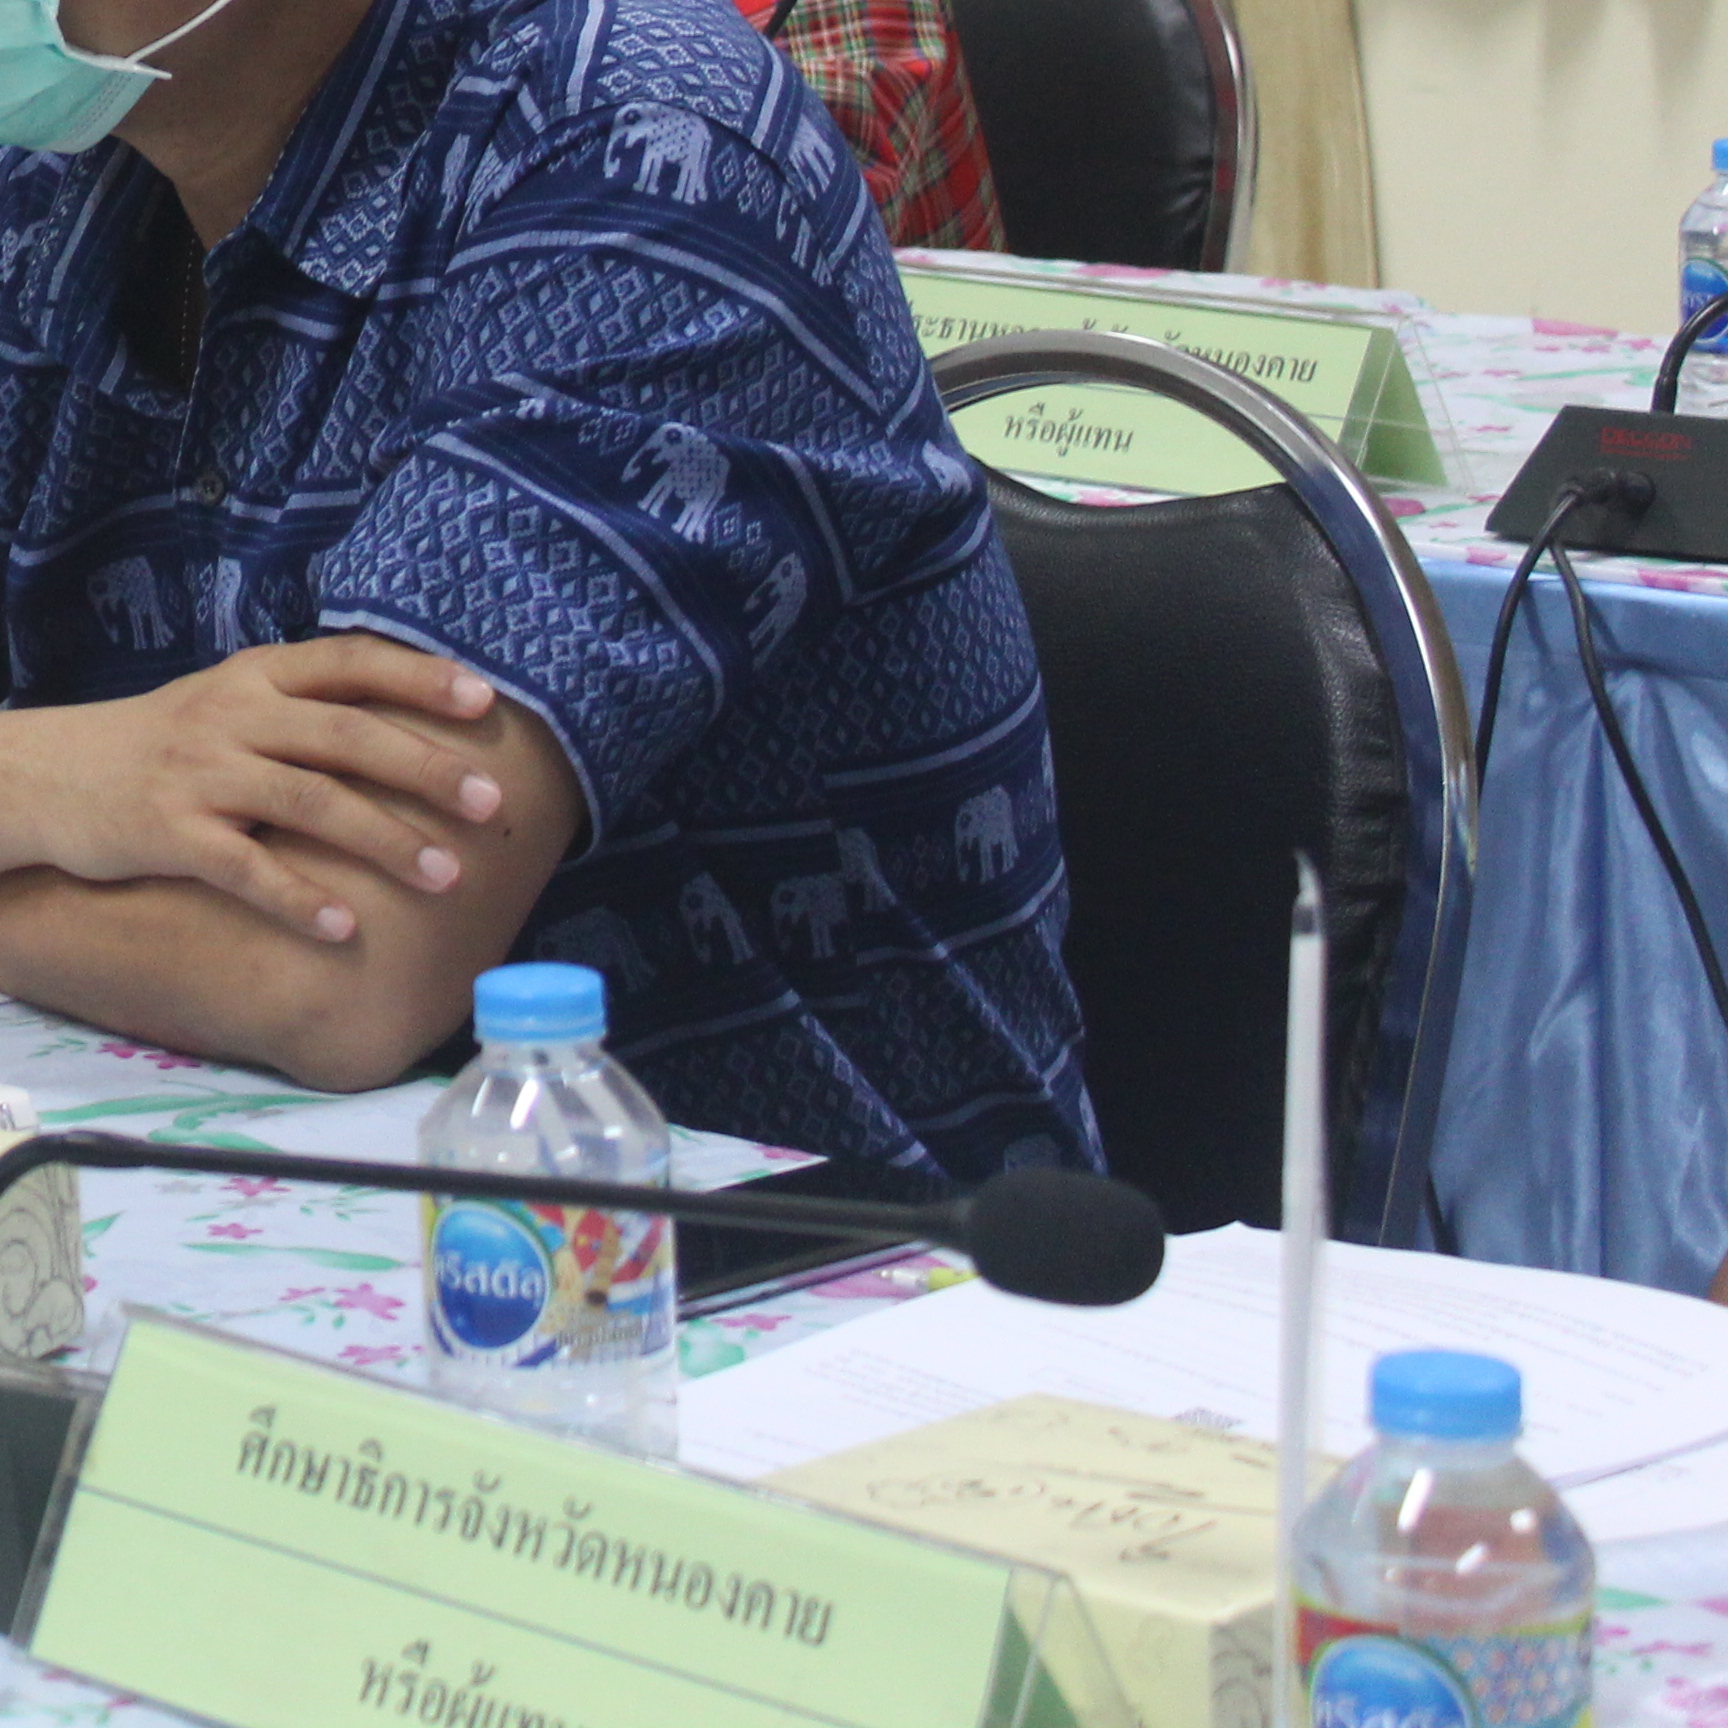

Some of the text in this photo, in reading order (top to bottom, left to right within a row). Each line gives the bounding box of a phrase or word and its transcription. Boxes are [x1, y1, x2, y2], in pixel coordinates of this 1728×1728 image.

[1004, 403, 1134, 457] หรือผู้แทน
[237, 1406, 834, 1648] ศึกษาธิการจังหวัดหนองคาย
